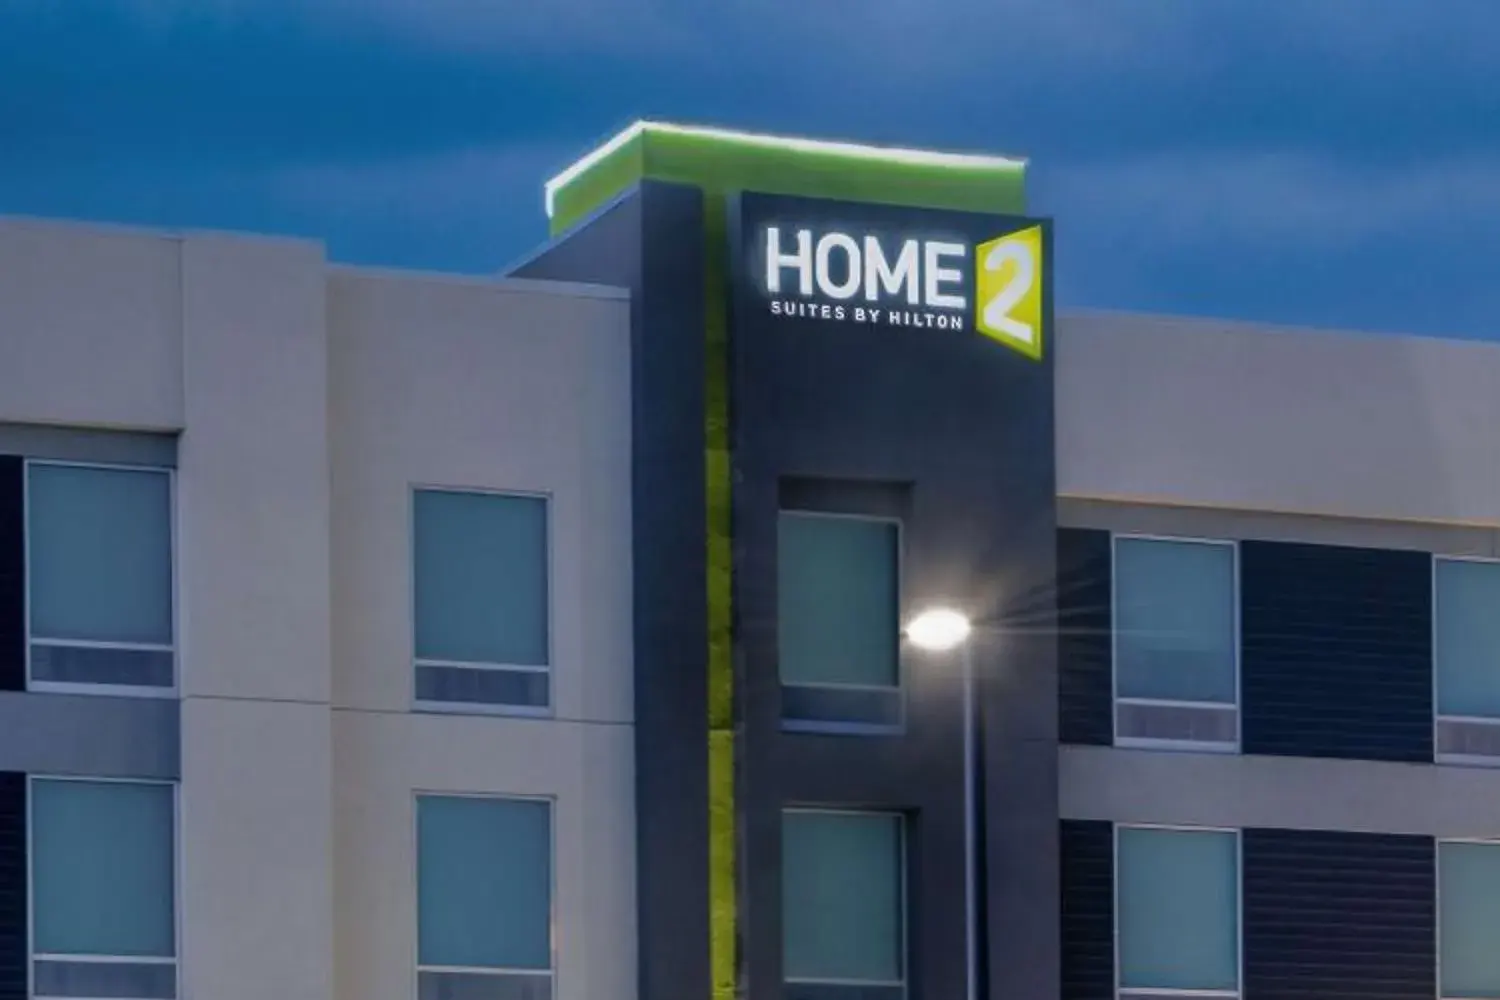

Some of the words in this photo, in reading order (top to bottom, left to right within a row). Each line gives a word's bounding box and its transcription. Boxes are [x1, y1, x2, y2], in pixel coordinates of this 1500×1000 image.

[766, 227, 967, 308] HOME
[982, 240, 1034, 344] 2
[770, 300, 846, 321] SUITES
[854, 307, 881, 323] BY
[888, 311, 964, 330] HILTON
